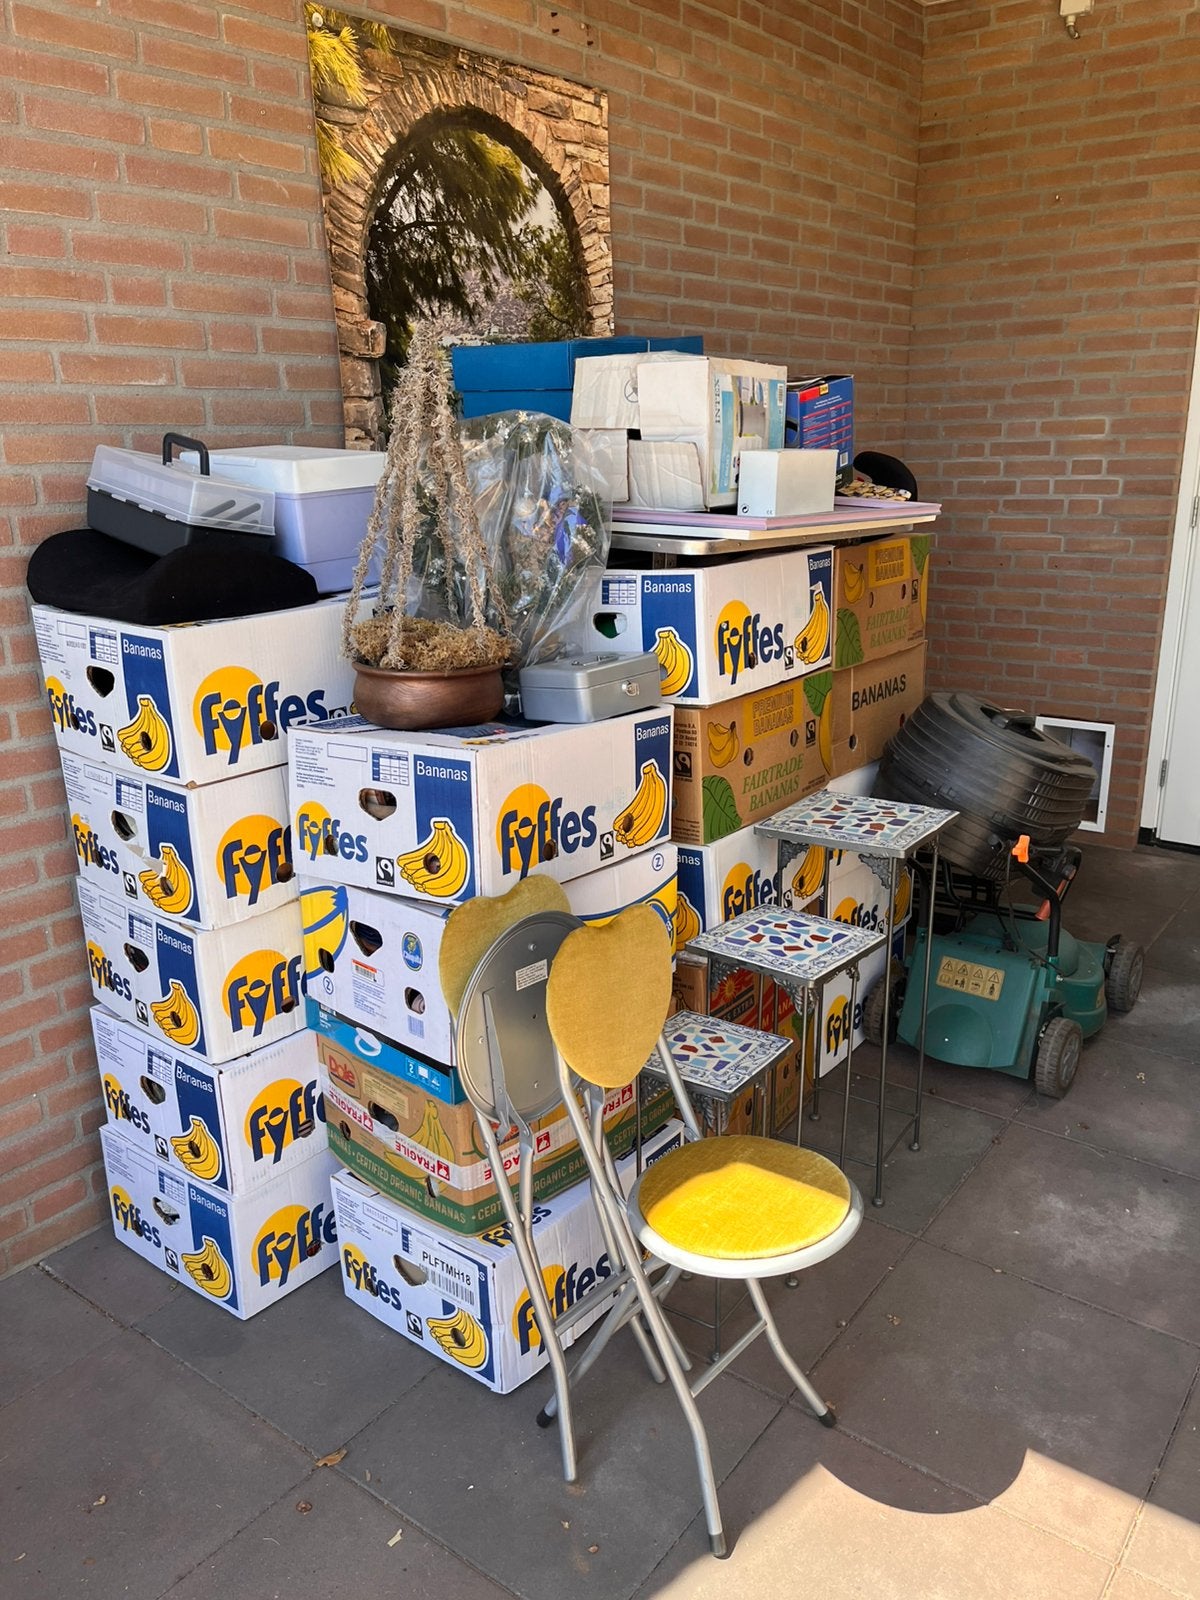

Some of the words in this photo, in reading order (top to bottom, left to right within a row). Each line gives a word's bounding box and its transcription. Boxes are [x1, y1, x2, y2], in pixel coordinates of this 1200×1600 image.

[809, 556, 831, 572] Bananas
[644, 579, 692, 595] Bananas
[866, 605, 910, 631] FAIRTRADE
[123, 638, 162, 661] Bananas
[870, 624, 907, 648] BANANAS
[753, 689, 794, 719] PREMIUM
[852, 674, 907, 712] BANANAS
[636, 721, 669, 742] Bananas
[753, 706, 794, 737] BANANAS
[417, 761, 468, 782] Bananas
[743, 753, 804, 794] FAIRTRADE
[148, 789, 185, 814] Bananas
[749, 776, 800, 812] BANANAS
[676, 854, 700, 866] anas
[157, 928, 192, 955] Bananas
[176, 1065, 213, 1093] Bananas
[329, 1054, 356, 1084] Dole
[329, 1090, 362, 1123] FRAGILE
[395, 1141, 436, 1175] FRAGILE
[356, 1151, 388, 1182] CERTIFIED
[390, 1175, 423, 1201] ORGANIC
[424, 1196, 466, 1224] BANANAS
[533, 1165, 567, 1192] RGANIC
[190, 1187, 227, 1218] Bananas
[422, 1251, 471, 1286] PLFTMH18
